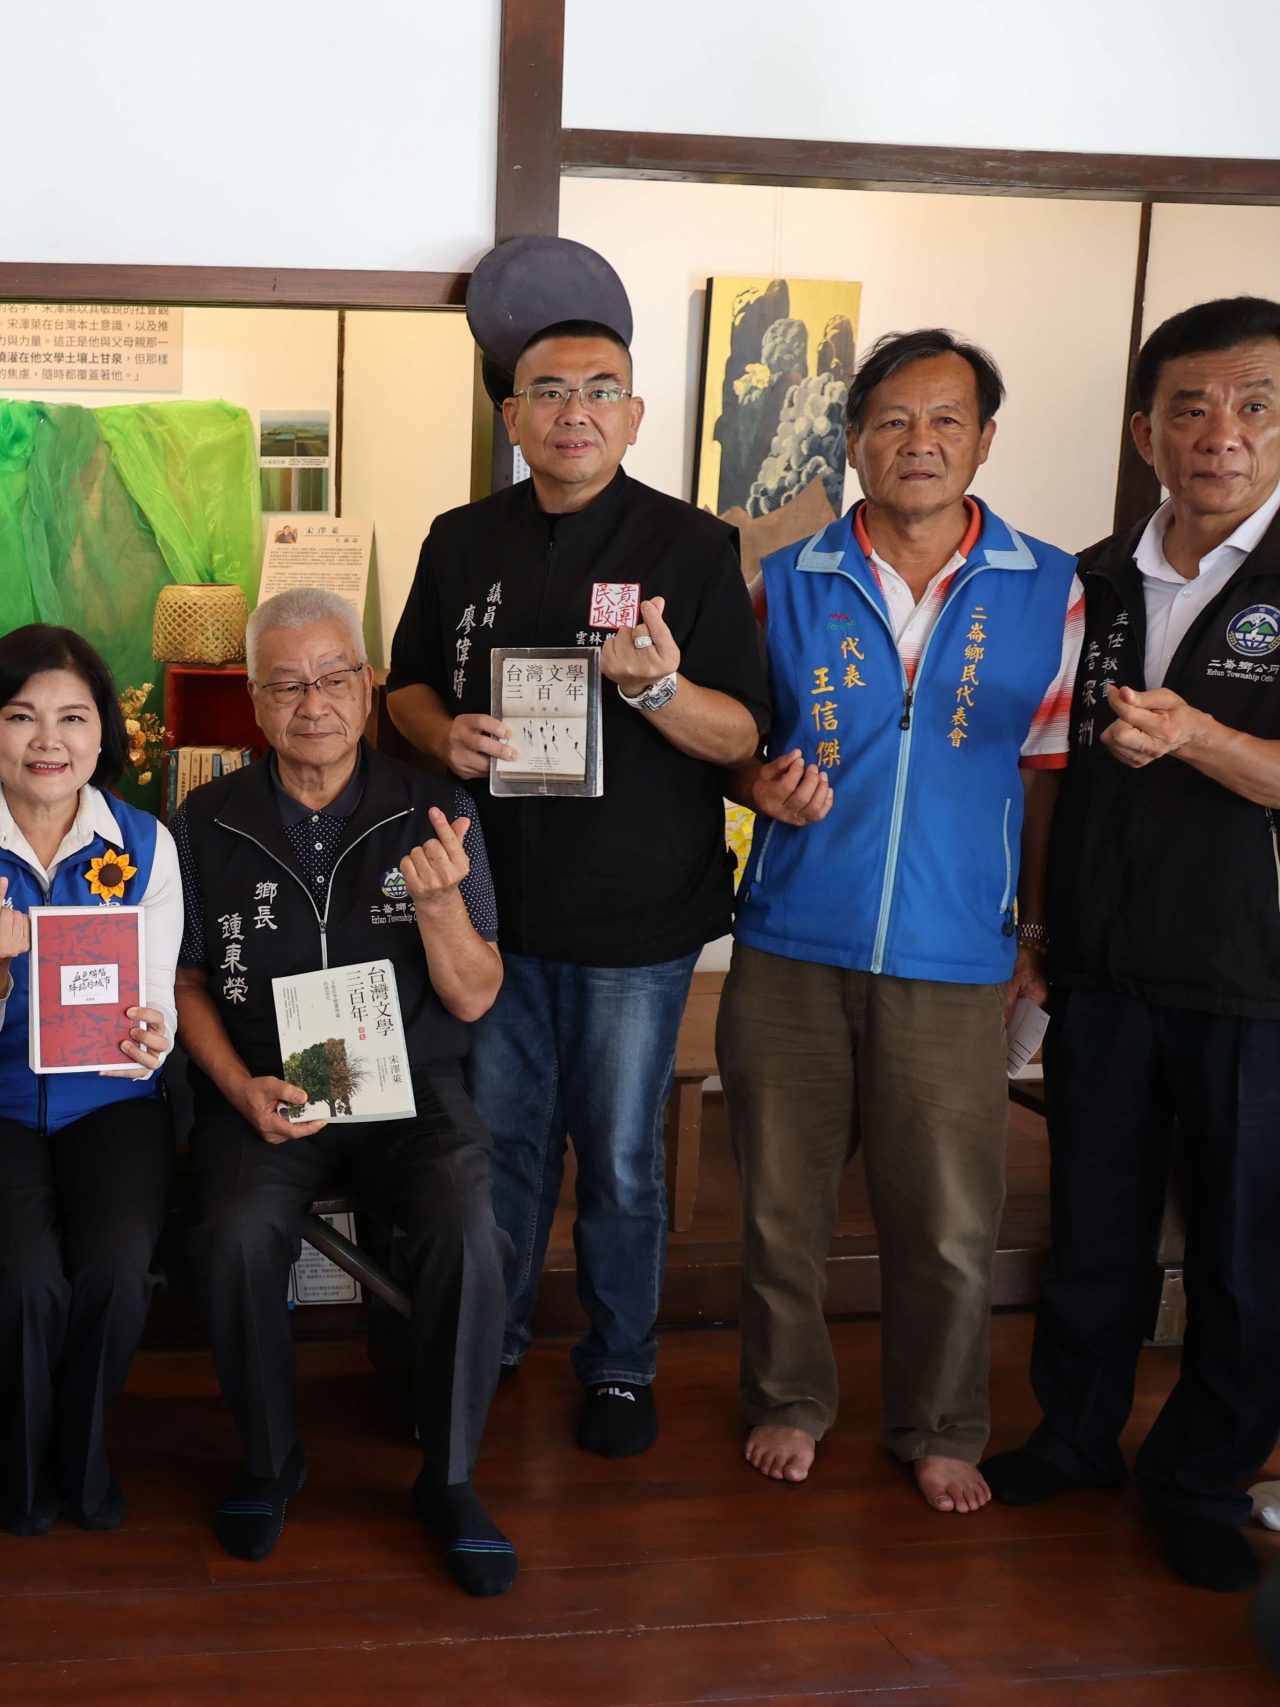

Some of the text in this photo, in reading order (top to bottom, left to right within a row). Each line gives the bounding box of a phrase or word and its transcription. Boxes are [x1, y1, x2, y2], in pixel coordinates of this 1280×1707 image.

[480, 580, 502, 629] 議員
[505, 663, 585, 683] 台灣文學
[840, 636, 867, 688] 代表
[947, 606, 988, 748] 二崙鄉民代表會
[505, 683, 585, 701] 三百年
[810, 666, 841, 769] 王信傑
[253, 880, 278, 930] 鄉長
[345, 970, 369, 1023] 三百年
[367, 966, 395, 1037] 台灣文學
[597, 1387, 636, 1402] FILA
